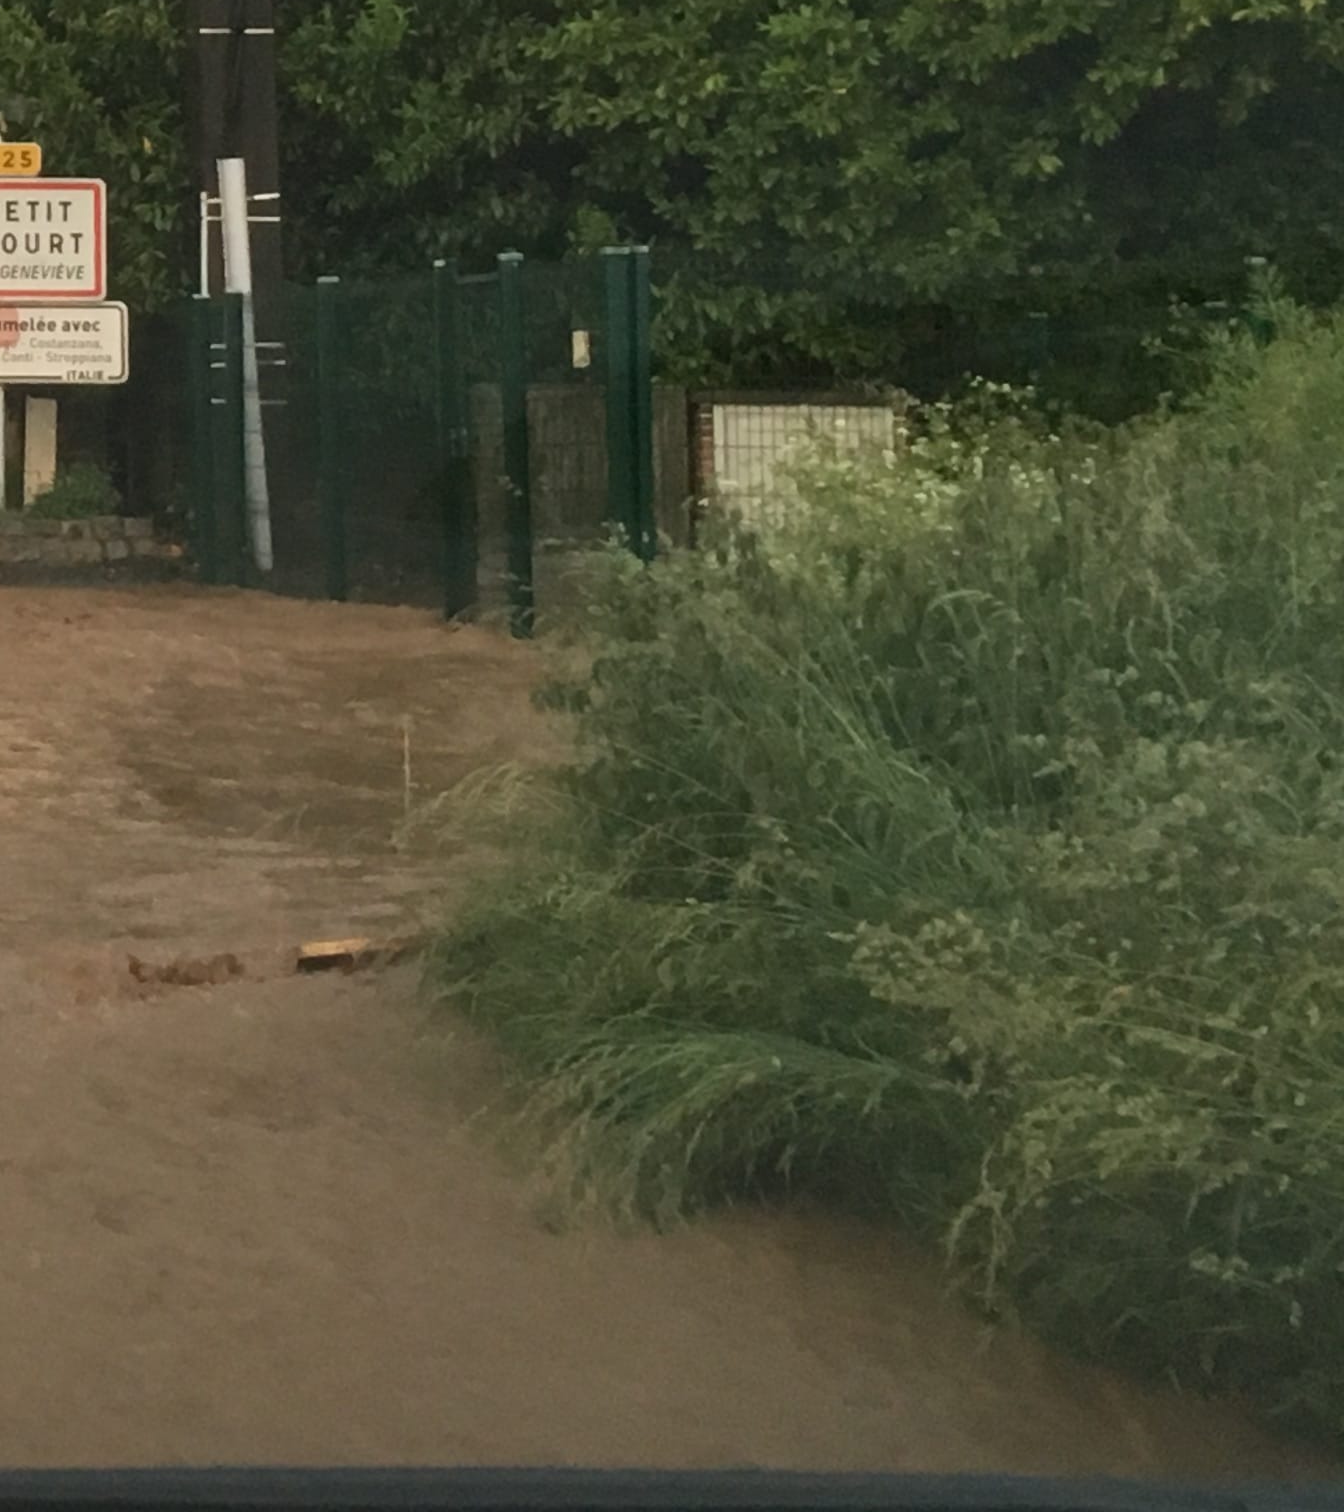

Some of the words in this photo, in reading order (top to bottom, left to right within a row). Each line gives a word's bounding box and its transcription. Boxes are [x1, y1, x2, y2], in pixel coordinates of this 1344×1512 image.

[0, 262, 85, 280] GENEVIÈVE
[62, 319, 101, 332] avec
[66, 370, 104, 380] ITALIE
